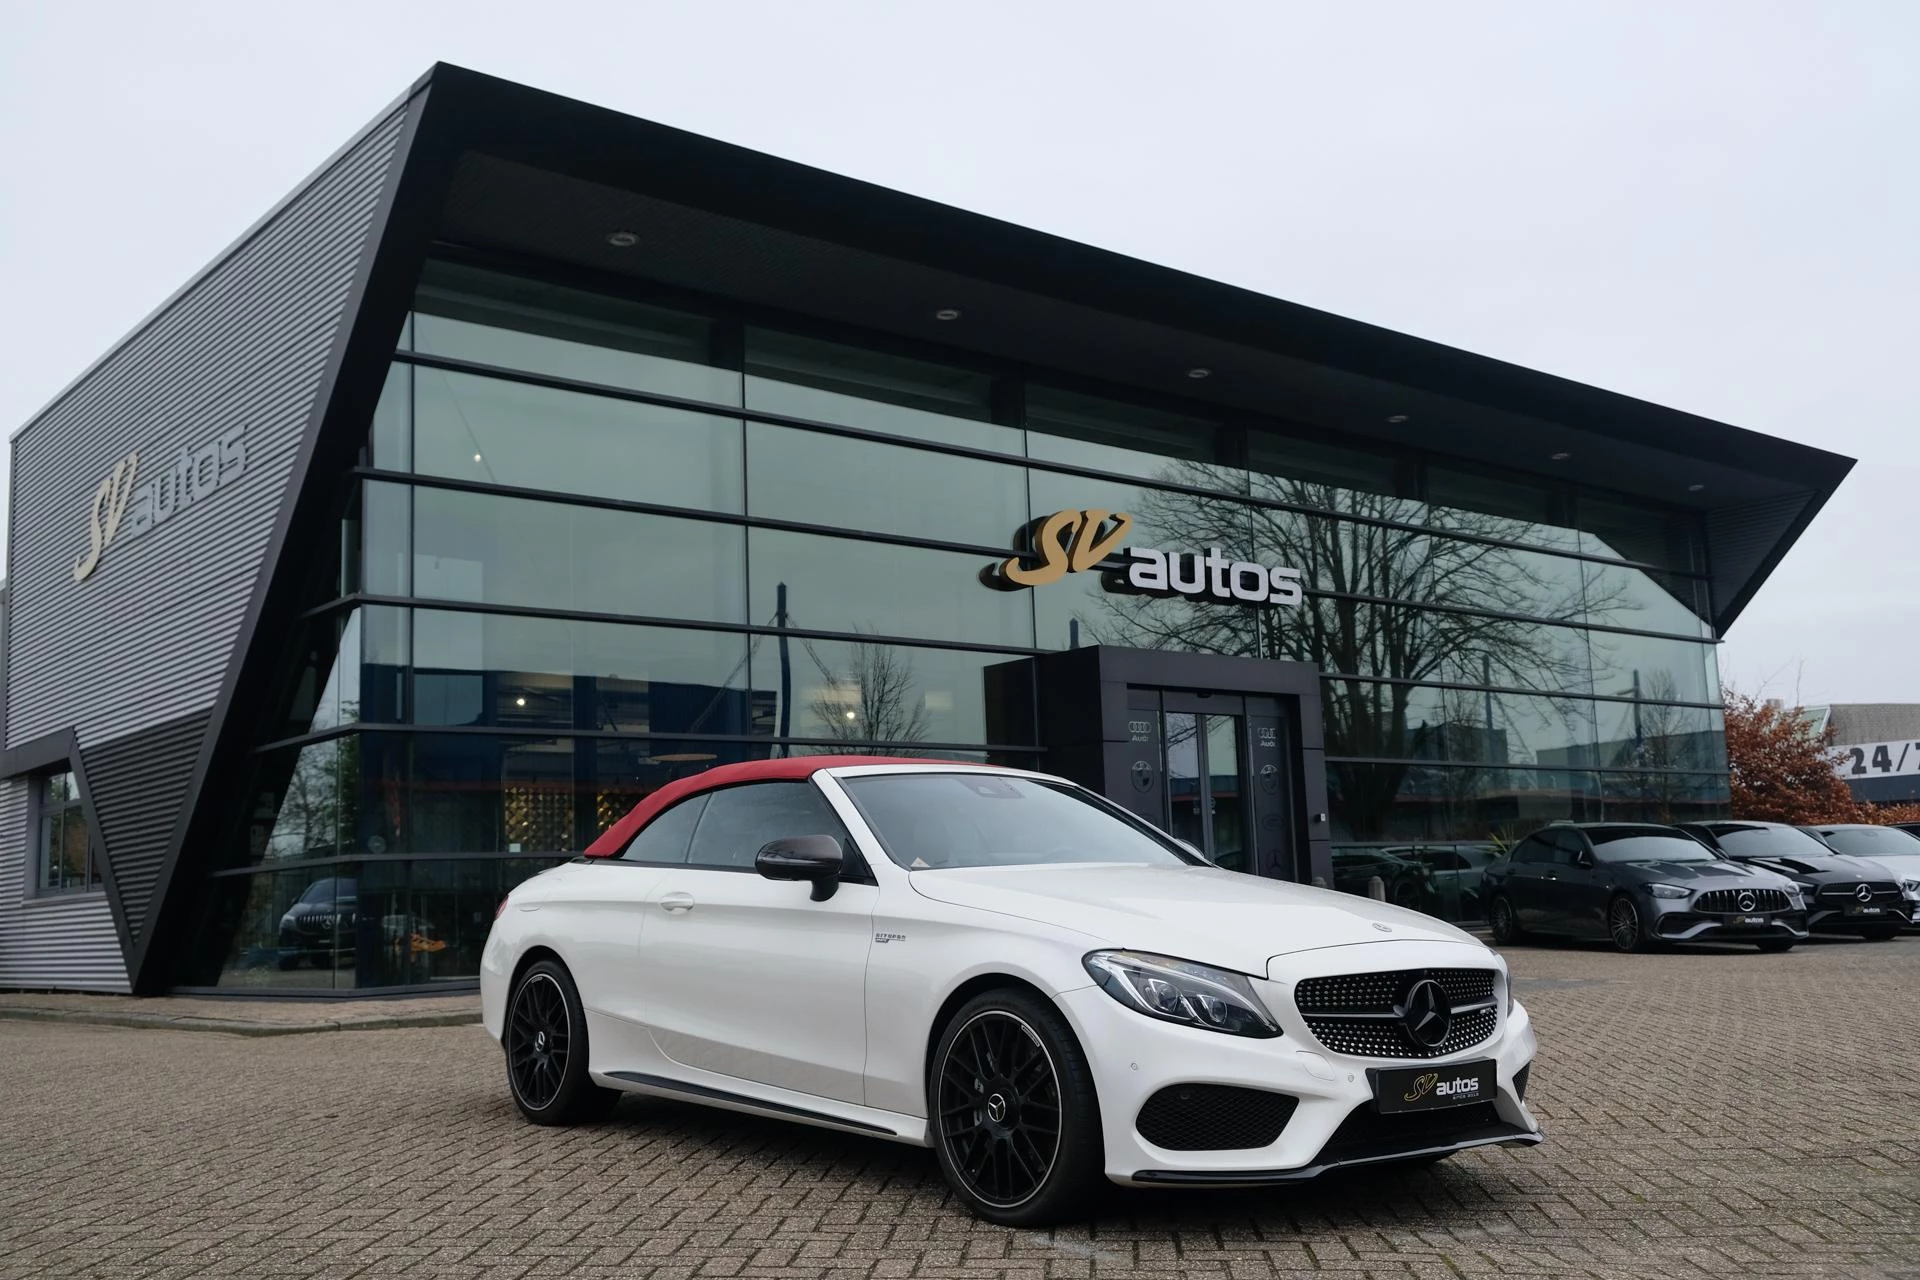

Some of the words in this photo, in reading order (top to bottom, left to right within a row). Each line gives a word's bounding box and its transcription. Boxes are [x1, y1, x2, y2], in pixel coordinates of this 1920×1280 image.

[131, 424, 249, 537] autos
[1005, 508, 1133, 586] SV
[1129, 547, 1303, 605] autos
[1404, 1073, 1438, 1101] SV
[1436, 1077, 1479, 1096] autos
